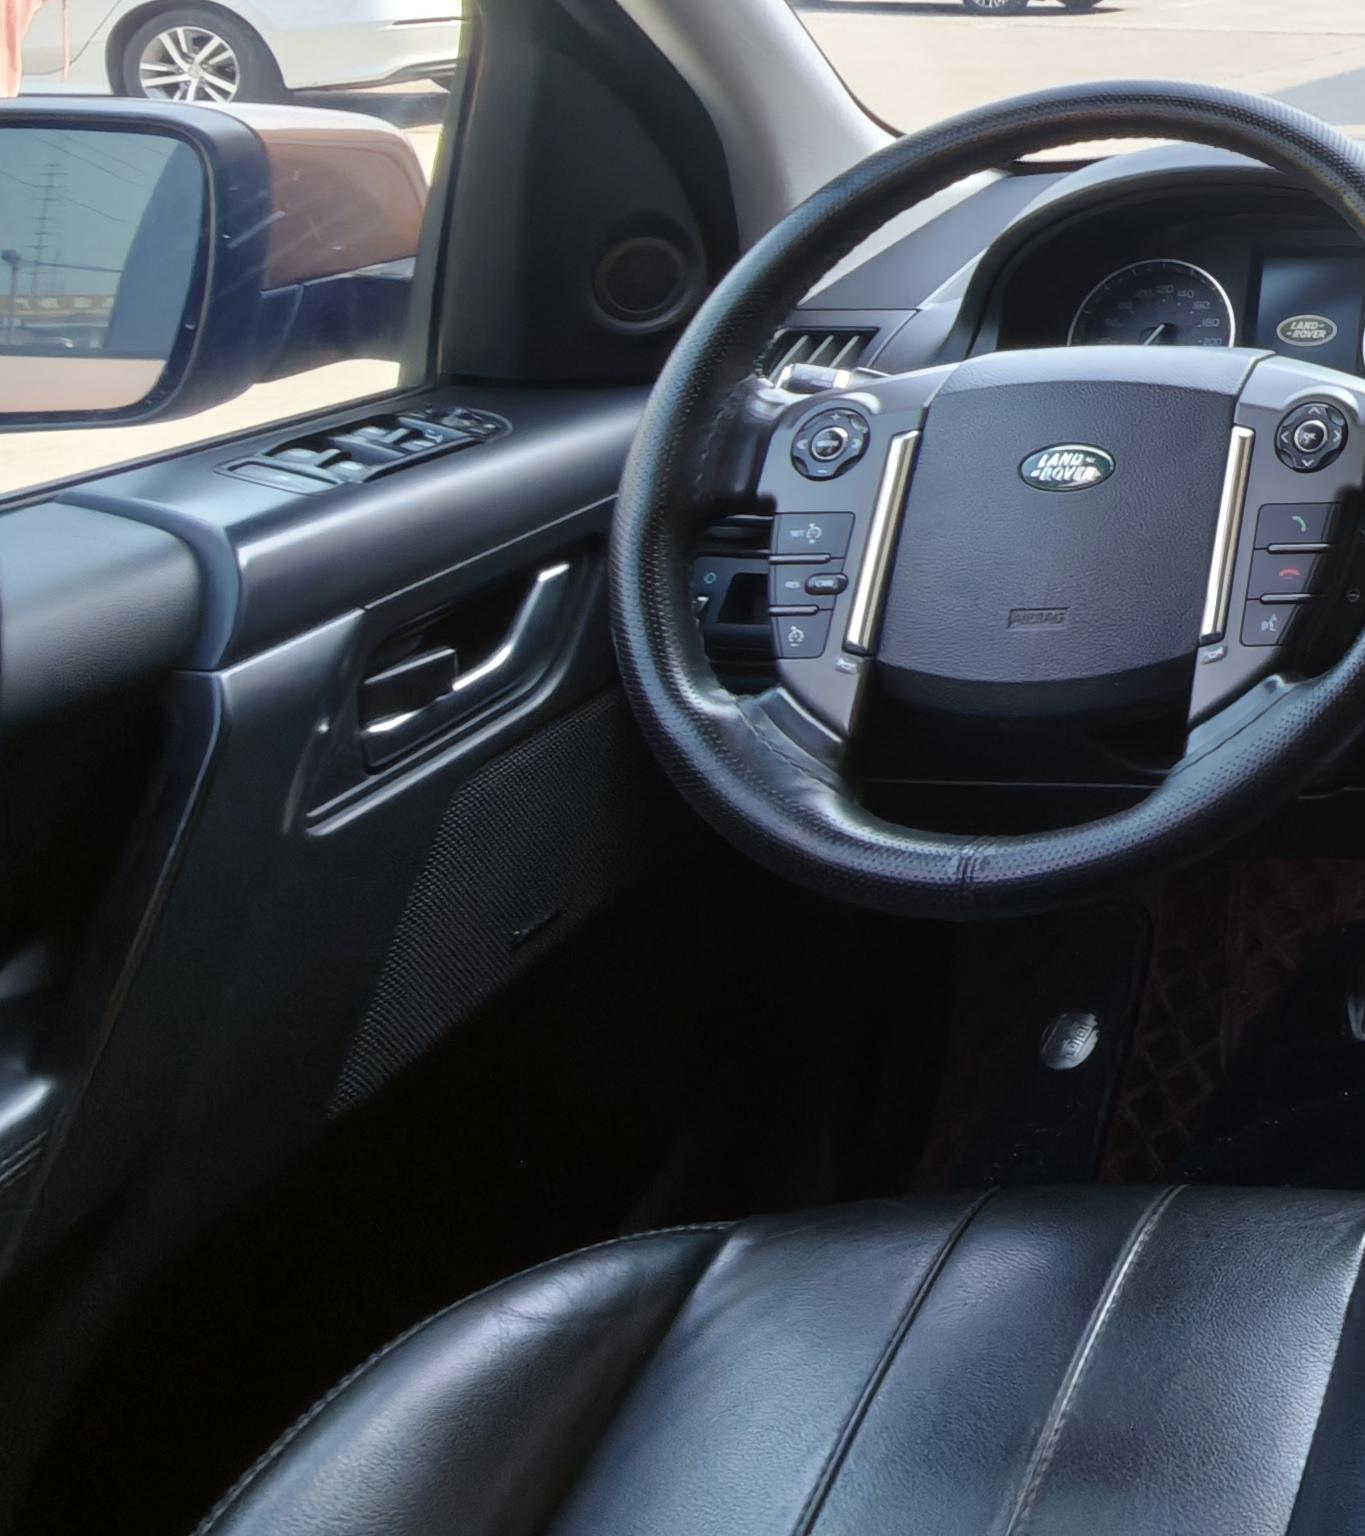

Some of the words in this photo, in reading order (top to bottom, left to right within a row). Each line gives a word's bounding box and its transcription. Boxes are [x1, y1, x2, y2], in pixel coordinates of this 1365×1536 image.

[1290, 321, 1317, 330] LAND
[1291, 330, 1327, 339] ROVER
[1037, 452, 1084, 468] LAND
[1039, 466, 1101, 481] ROVER
